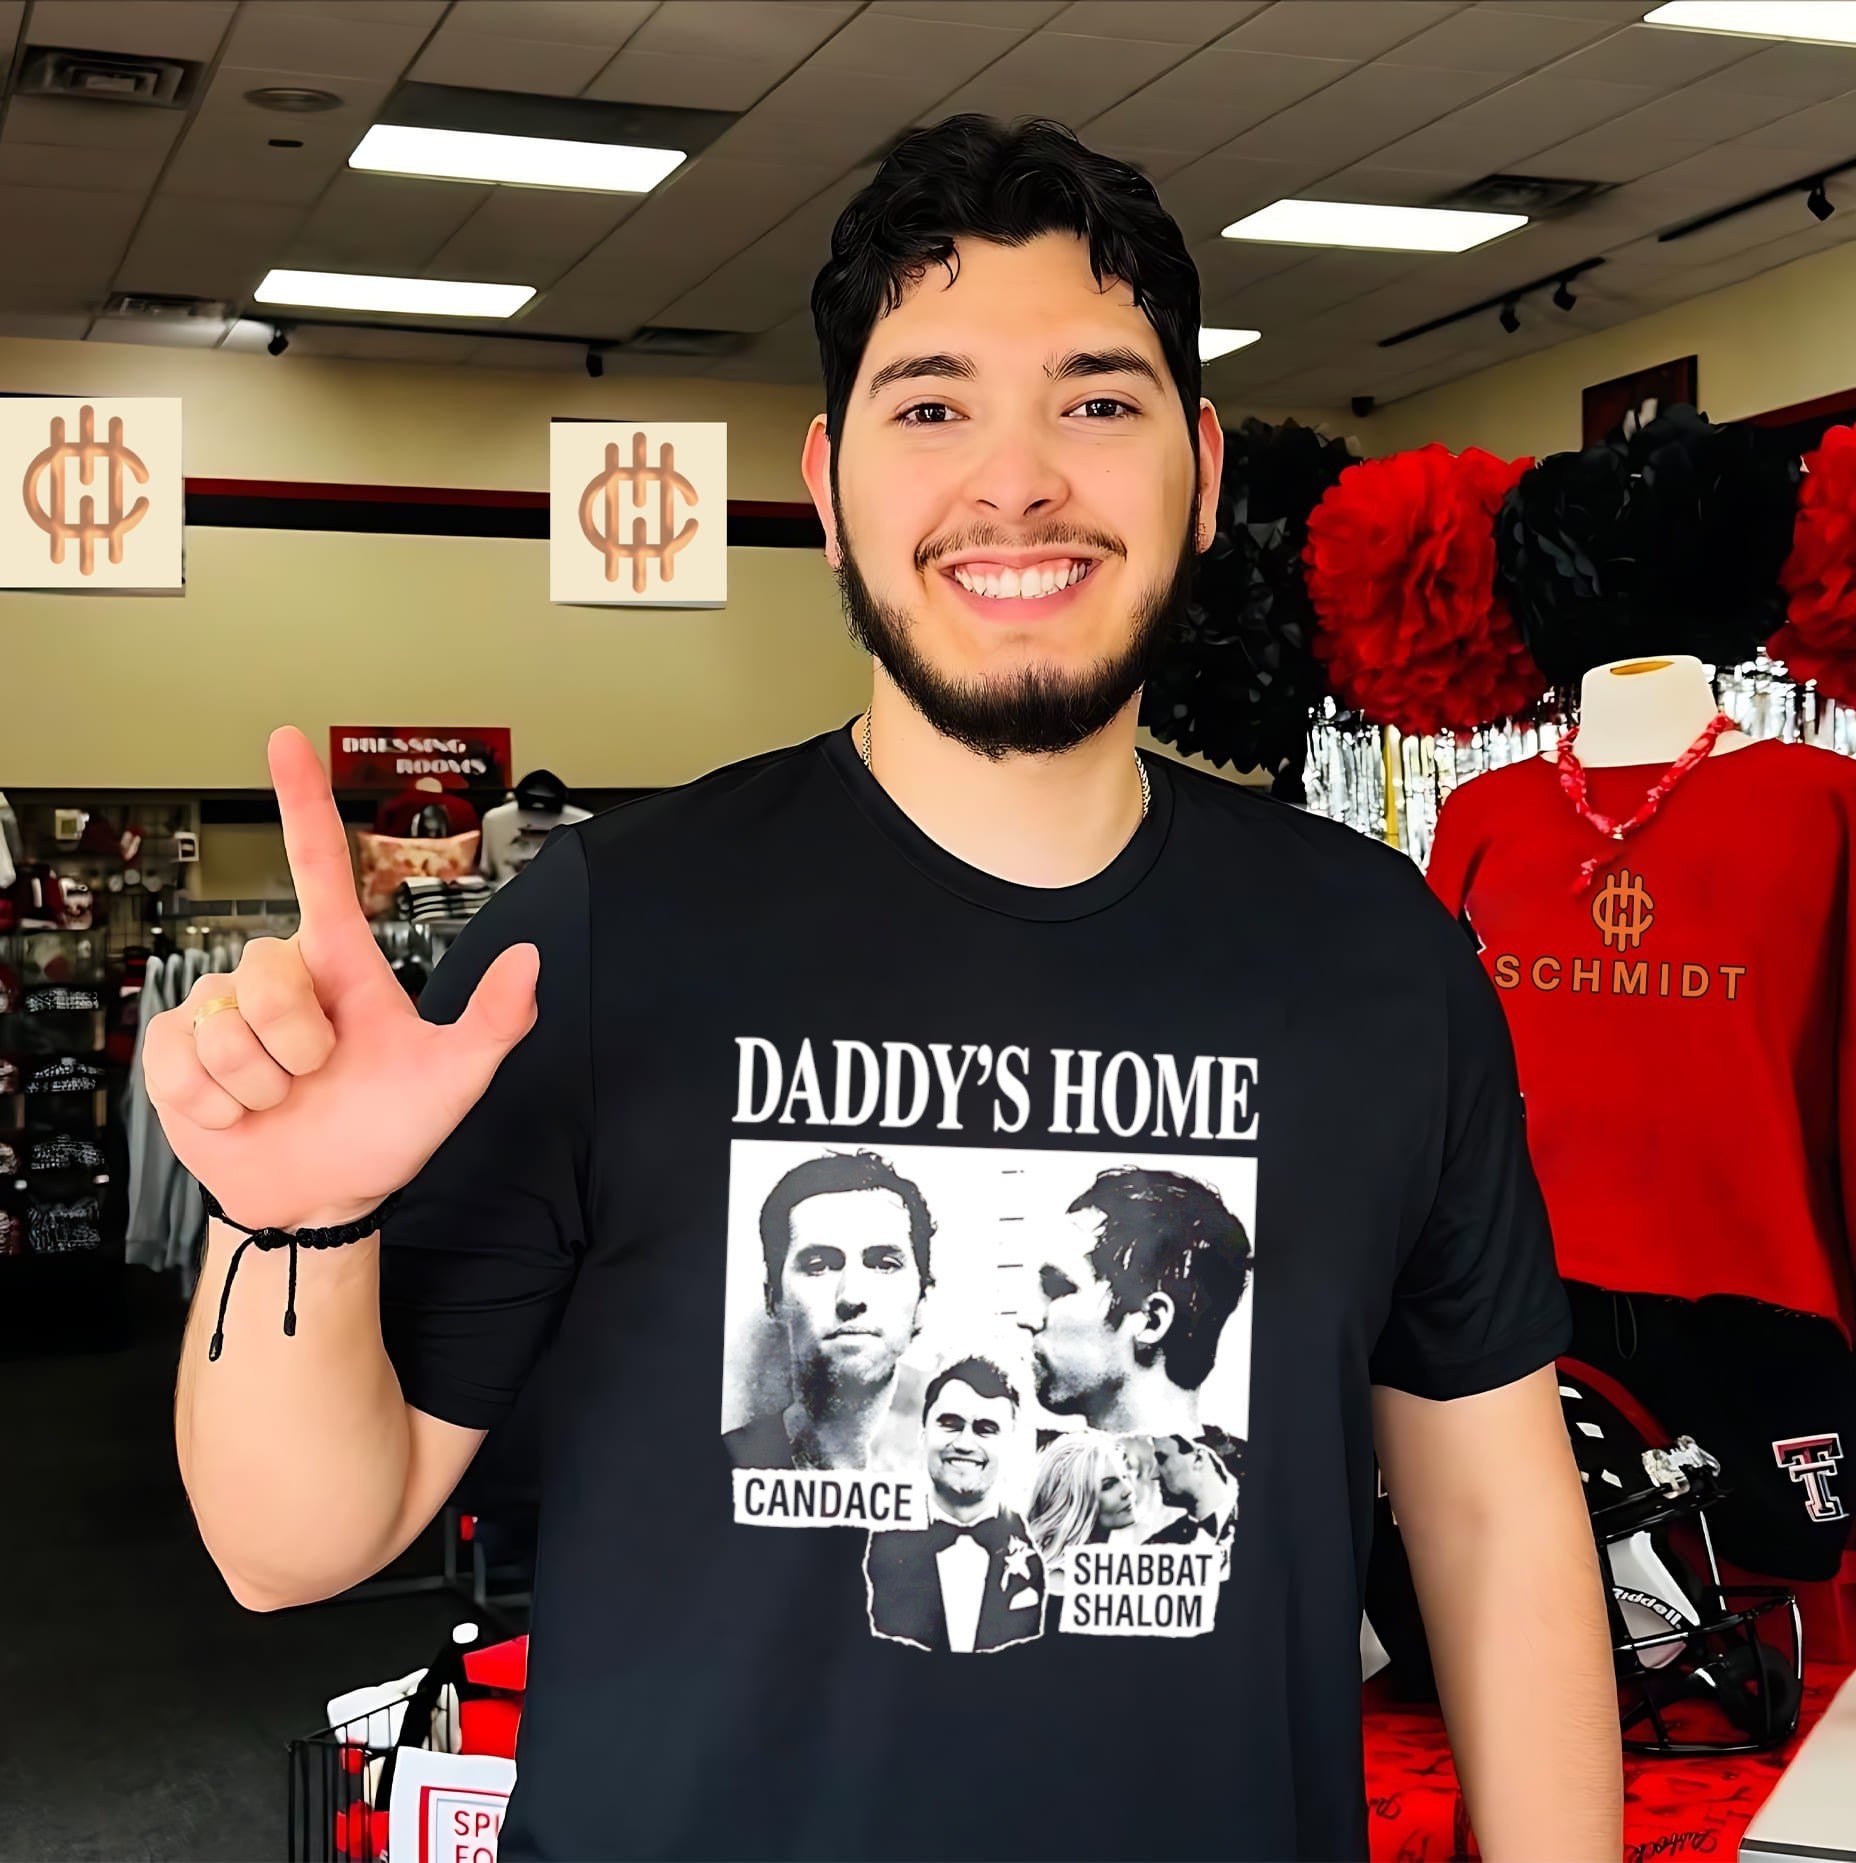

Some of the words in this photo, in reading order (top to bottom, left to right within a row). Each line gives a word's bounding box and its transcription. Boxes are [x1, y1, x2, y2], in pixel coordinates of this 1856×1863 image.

[342, 737, 466, 753] DRESSING
[396, 759, 487, 775] ROOMS
[1494, 953, 1747, 1000] SCHMIDT
[731, 1036, 1031, 1133] DADDY’S
[1048, 1048, 1259, 1140] HOME
[745, 1477, 912, 1521] CANDACE
[1073, 1552, 1214, 1586] SHABBAT
[1073, 1593, 1201, 1627] SHALOM
